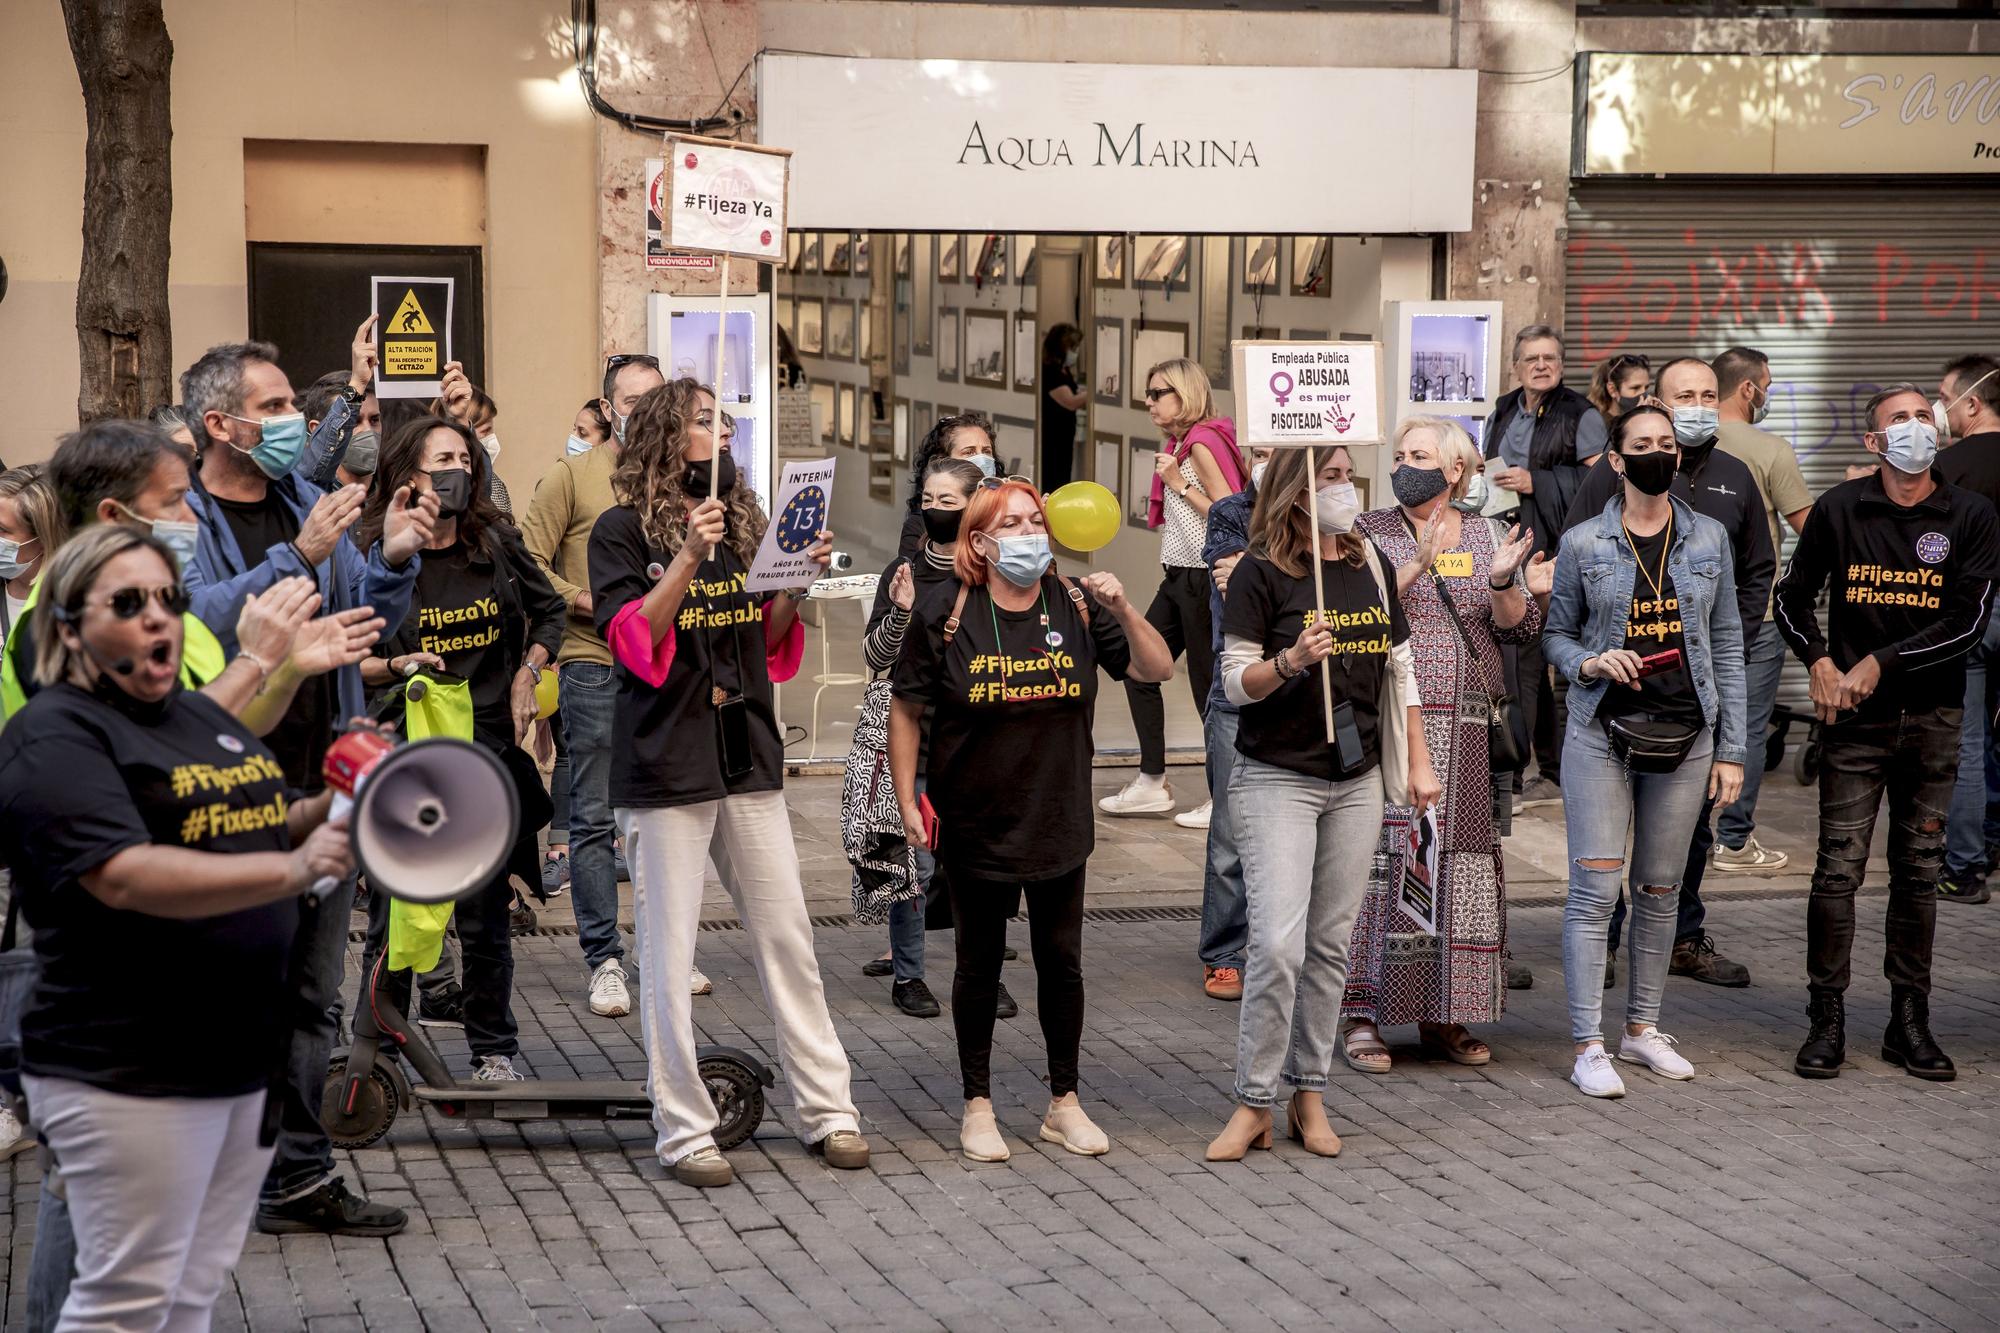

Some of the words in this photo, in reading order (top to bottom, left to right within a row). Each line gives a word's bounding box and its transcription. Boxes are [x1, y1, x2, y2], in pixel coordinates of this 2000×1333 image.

[684, 193, 747, 215] #Fijeza
[753, 200, 772, 218] Ya
[649, 257, 711, 266] VIDEOVIGILANCIA
[1271, 352, 1315, 366] Empleada
[1317, 351, 1350, 364] Pública
[1298, 368, 1349, 385] ABUSADA
[1299, 394, 1313, 402] es
[1316, 392, 1351, 404] mujer
[1272, 413, 1322, 429] PISOTEADA
[789, 469, 833, 485] INTERINA
[792, 506, 816, 531] 13
[772, 559, 793, 568] AÑOS
[1449, 559, 1464, 568] YA
[756, 571, 786, 579] FRAUDE
[797, 569, 813, 577] LEY
[1847, 564, 1943, 587] #FijezaYa
[1846, 587, 1940, 609] #FixesaJa
[968, 650, 1074, 677] #FijezaYa
[968, 678, 1082, 703] #FixesaJa
